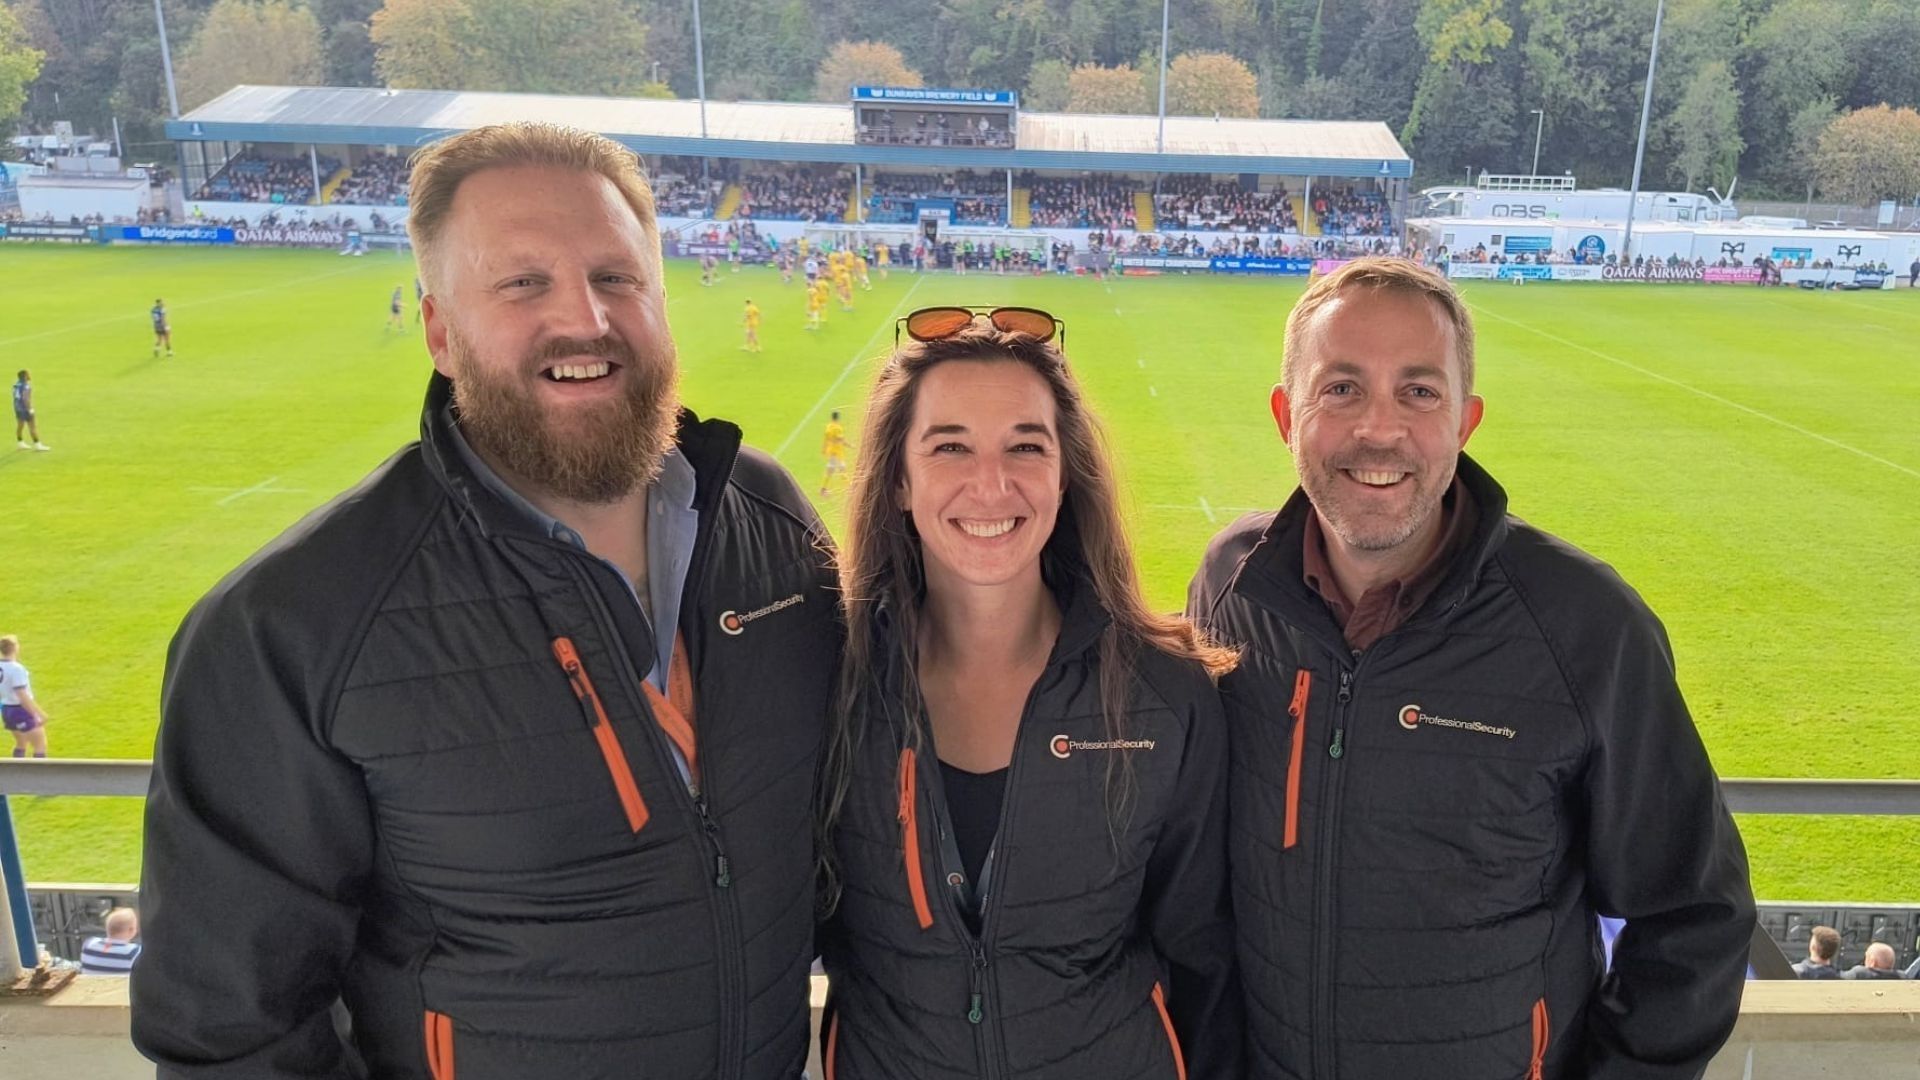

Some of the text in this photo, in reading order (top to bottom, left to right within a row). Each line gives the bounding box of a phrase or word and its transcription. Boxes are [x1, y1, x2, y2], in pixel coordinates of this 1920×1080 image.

[925, 91, 960, 100] BREWERY
[961, 92, 982, 101] FIELD
[235, 229, 343, 243] QATAR AIRWAYS
[1603, 266, 1647, 279] QATAR
[1649, 266, 1703, 279] AIRWAYS
[1419, 713, 1516, 739] ProfessionalSecurity
[1069, 739, 1155, 751] ProfessionalSecurity
